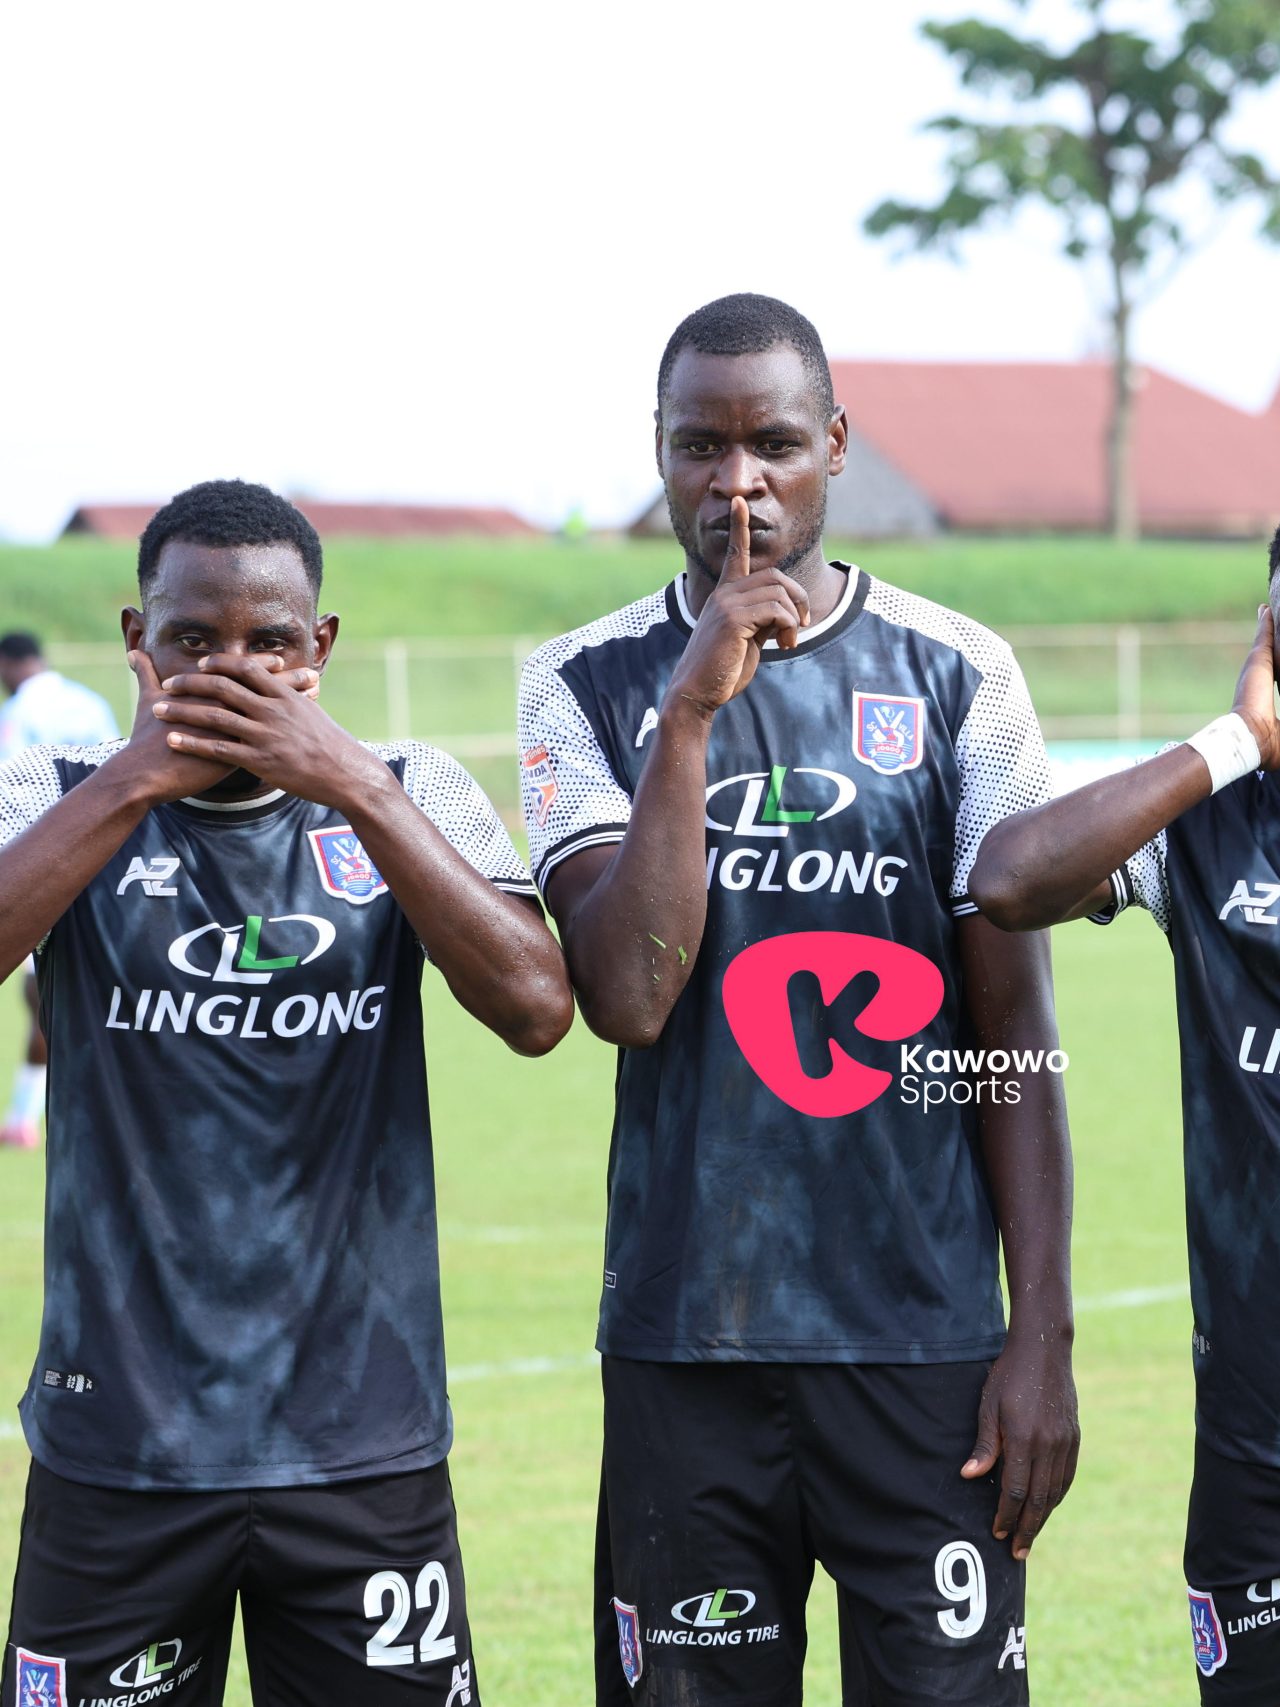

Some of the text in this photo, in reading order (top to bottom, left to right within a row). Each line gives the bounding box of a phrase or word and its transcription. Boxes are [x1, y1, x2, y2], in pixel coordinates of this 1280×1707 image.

[105, 985, 386, 1039] LINGLONG
[363, 1560, 457, 1667] 22
[934, 1540, 988, 1639] 9
[646, 1628, 742, 1647] LINGLONG
[746, 1623, 780, 1644] TIRE
[177, 1656, 204, 1687] TIRE
